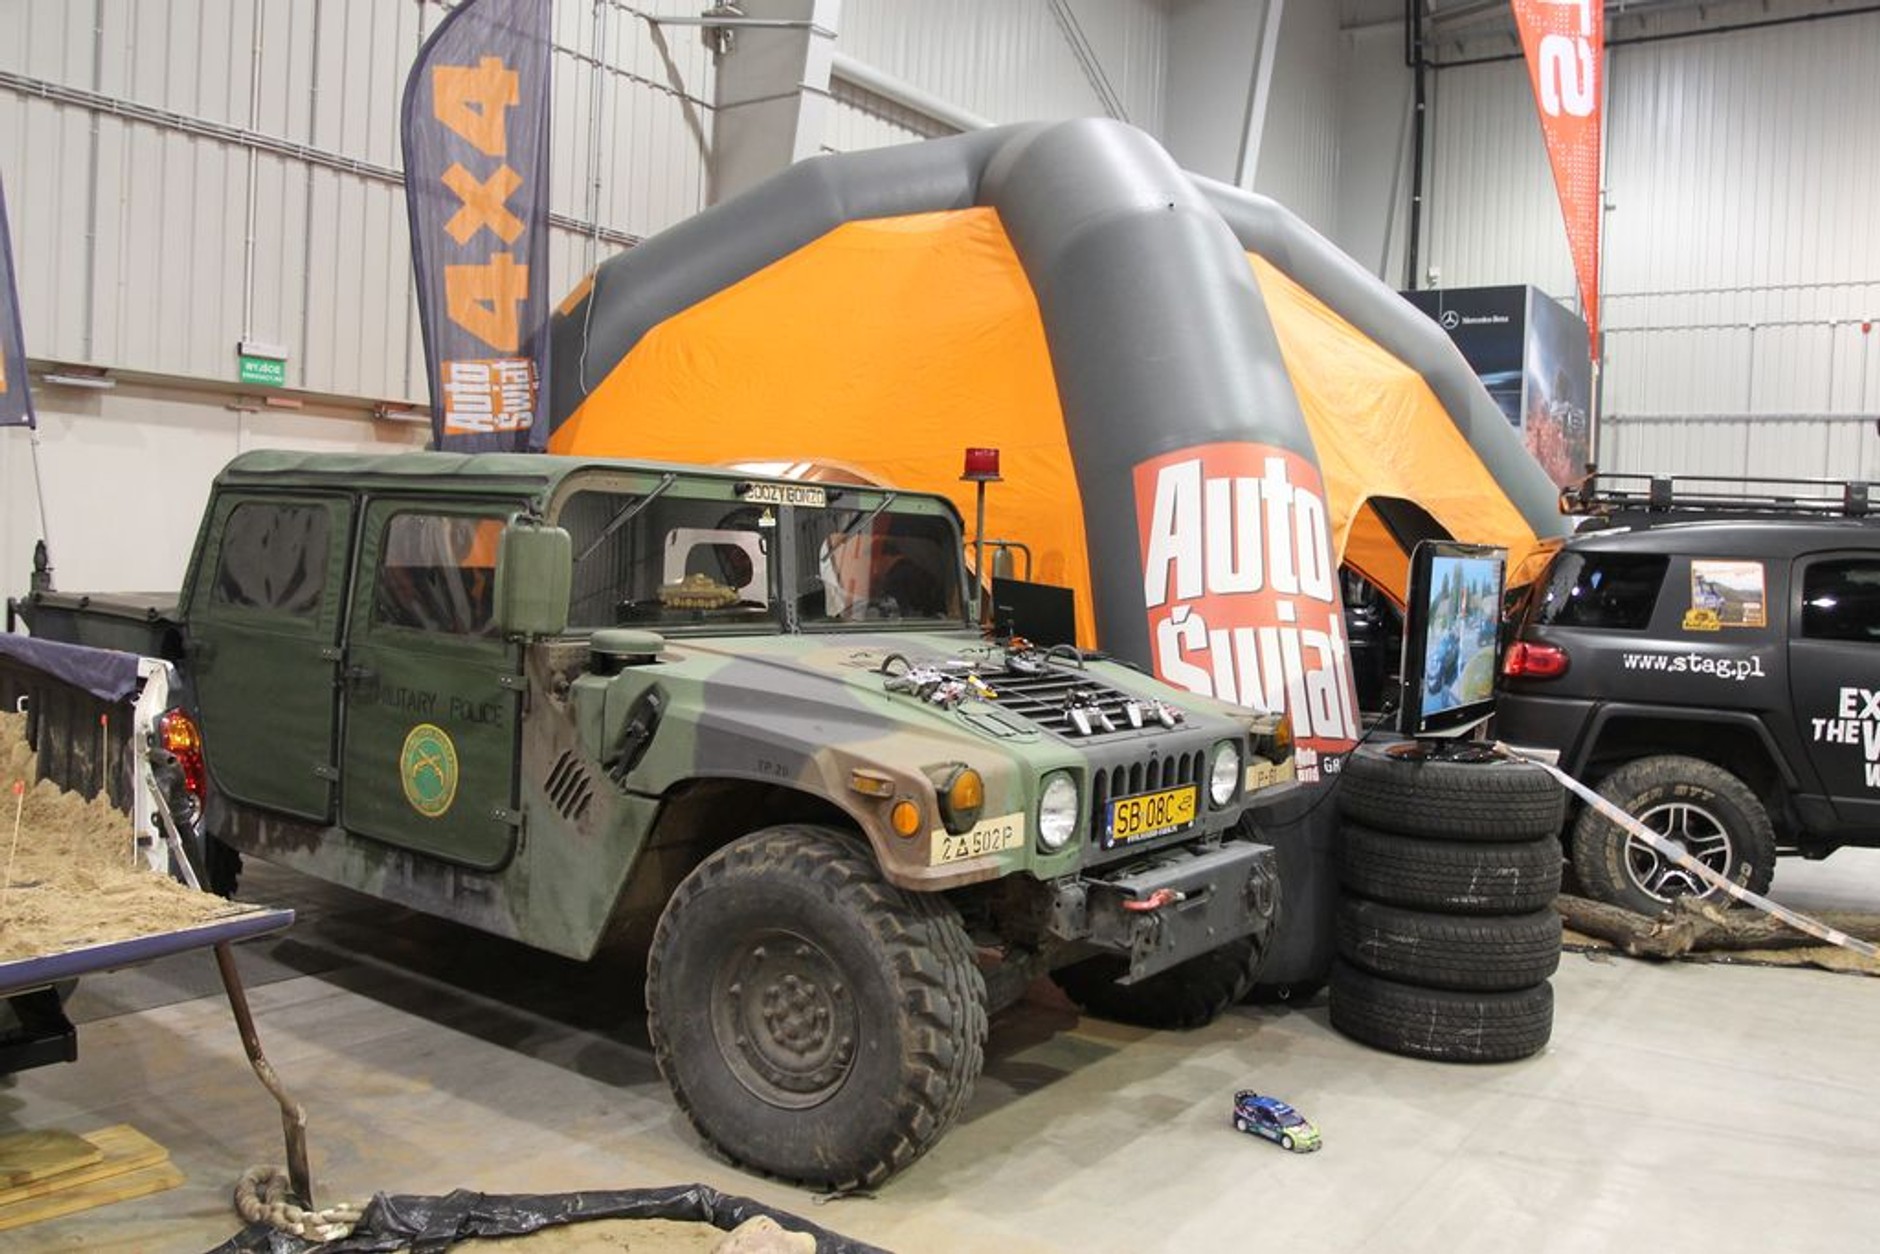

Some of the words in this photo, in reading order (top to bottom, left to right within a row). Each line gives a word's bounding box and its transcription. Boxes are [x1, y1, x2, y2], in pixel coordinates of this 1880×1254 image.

[1144, 457, 1333, 608] Auto
[1623, 652, 1766, 681] www.stag.pl
[450, 696, 504, 728] POLICE
[1811, 718, 1861, 744] THE
[1117, 802, 1141, 834] SB
[1146, 794, 1174, 827] 08C
